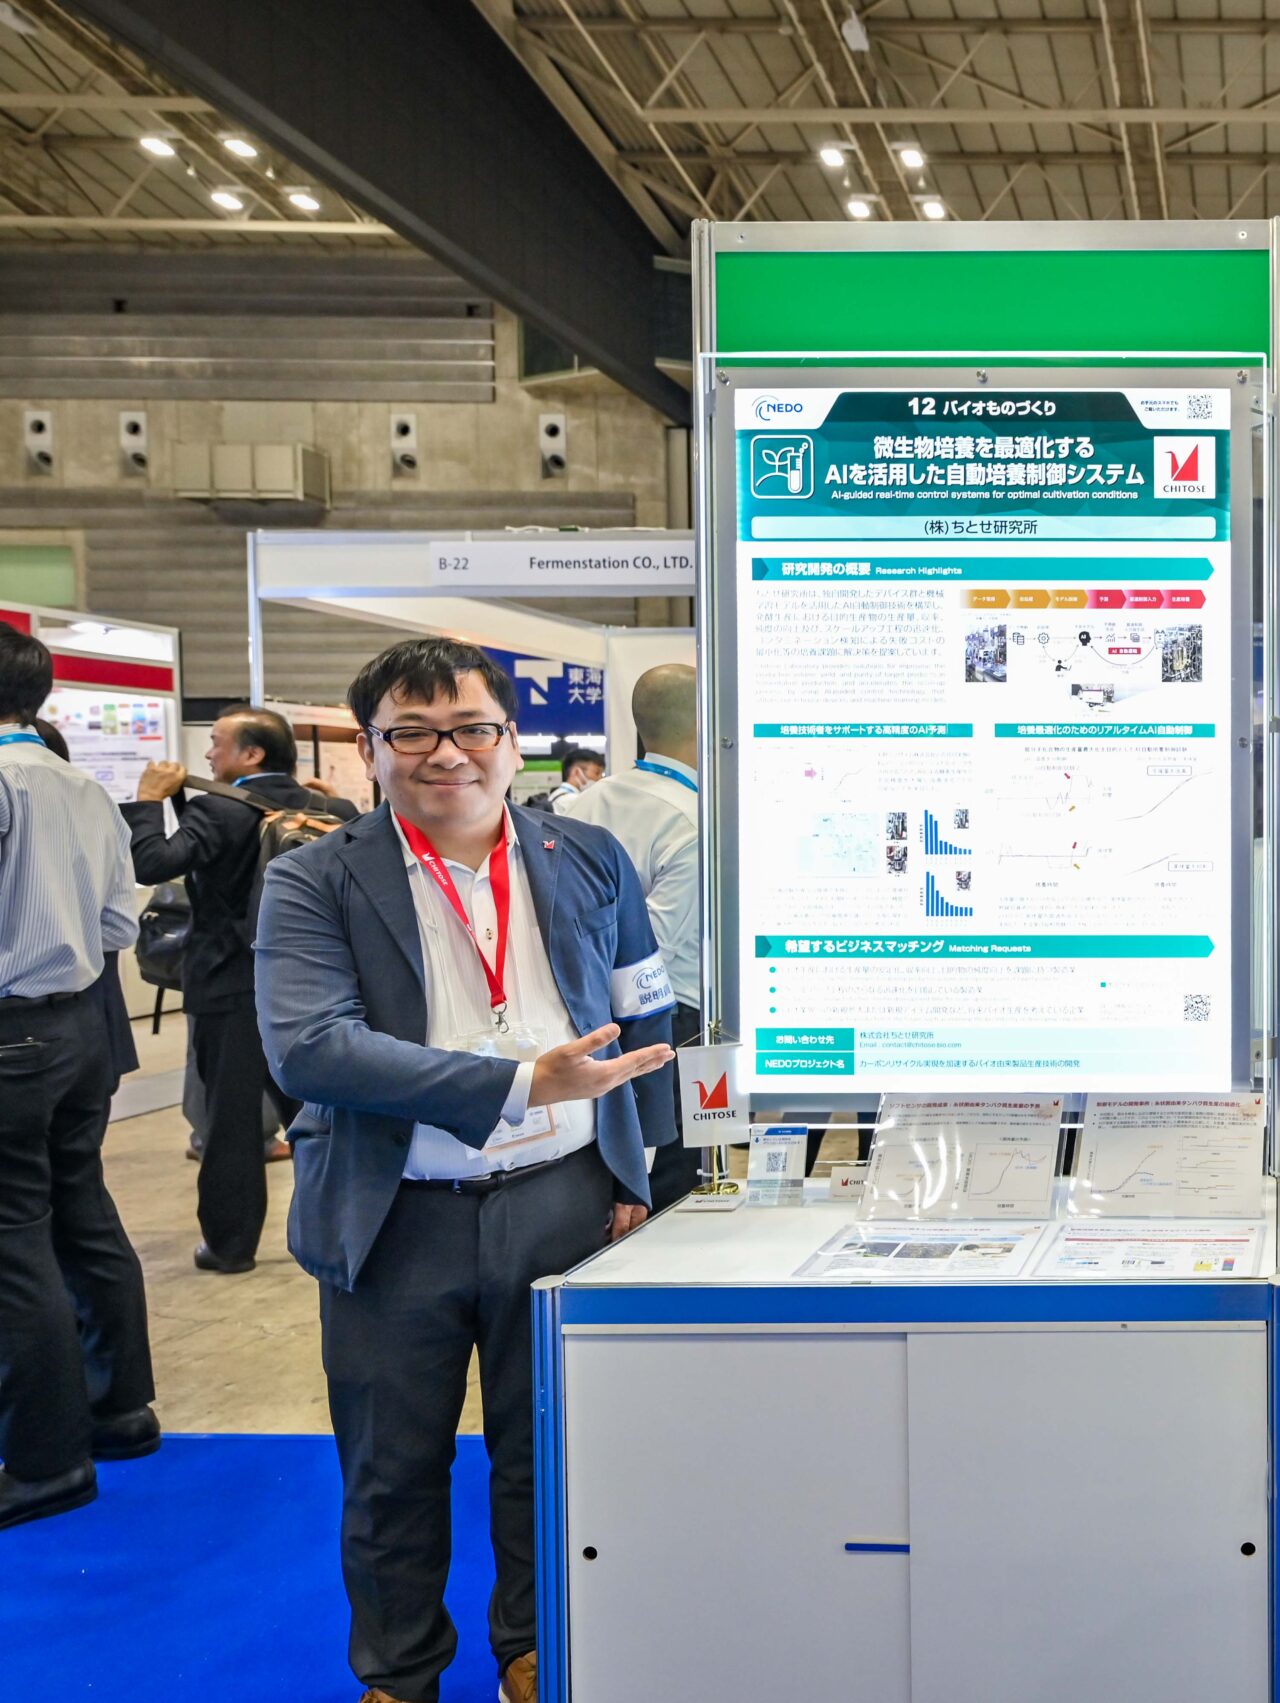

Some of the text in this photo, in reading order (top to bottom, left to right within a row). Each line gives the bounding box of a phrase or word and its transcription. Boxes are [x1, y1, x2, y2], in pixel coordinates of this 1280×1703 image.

[766, 403, 803, 413] NEDO
[908, 397, 1057, 416] 12 バイオものづくり
[873, 435, 1095, 460] 微生物培養を最適化する
[824, 462, 1145, 487] AIを活用した自動培養制御システム
[831, 490, 1138, 500] AI-guided real-time control systems for optimal cultivation conditions
[1163, 484, 1206, 493] CHITOSE
[438, 556, 693, 571] B-22 Fermenstation CO., LTD.
[781, 562, 963, 577] 研究開発の概要 Research Highlights
[428, 860, 449, 886] CHITOSE
[785, 939, 1032, 953] 希望するビジネスマッチング Matching Requests
[645, 965, 666, 982] NEDO
[775, 1035, 835, 1045] お問い合わせ先
[765, 1059, 845, 1069] NEDOプロジェクト名
[693, 1110, 737, 1121] CHITOSE
